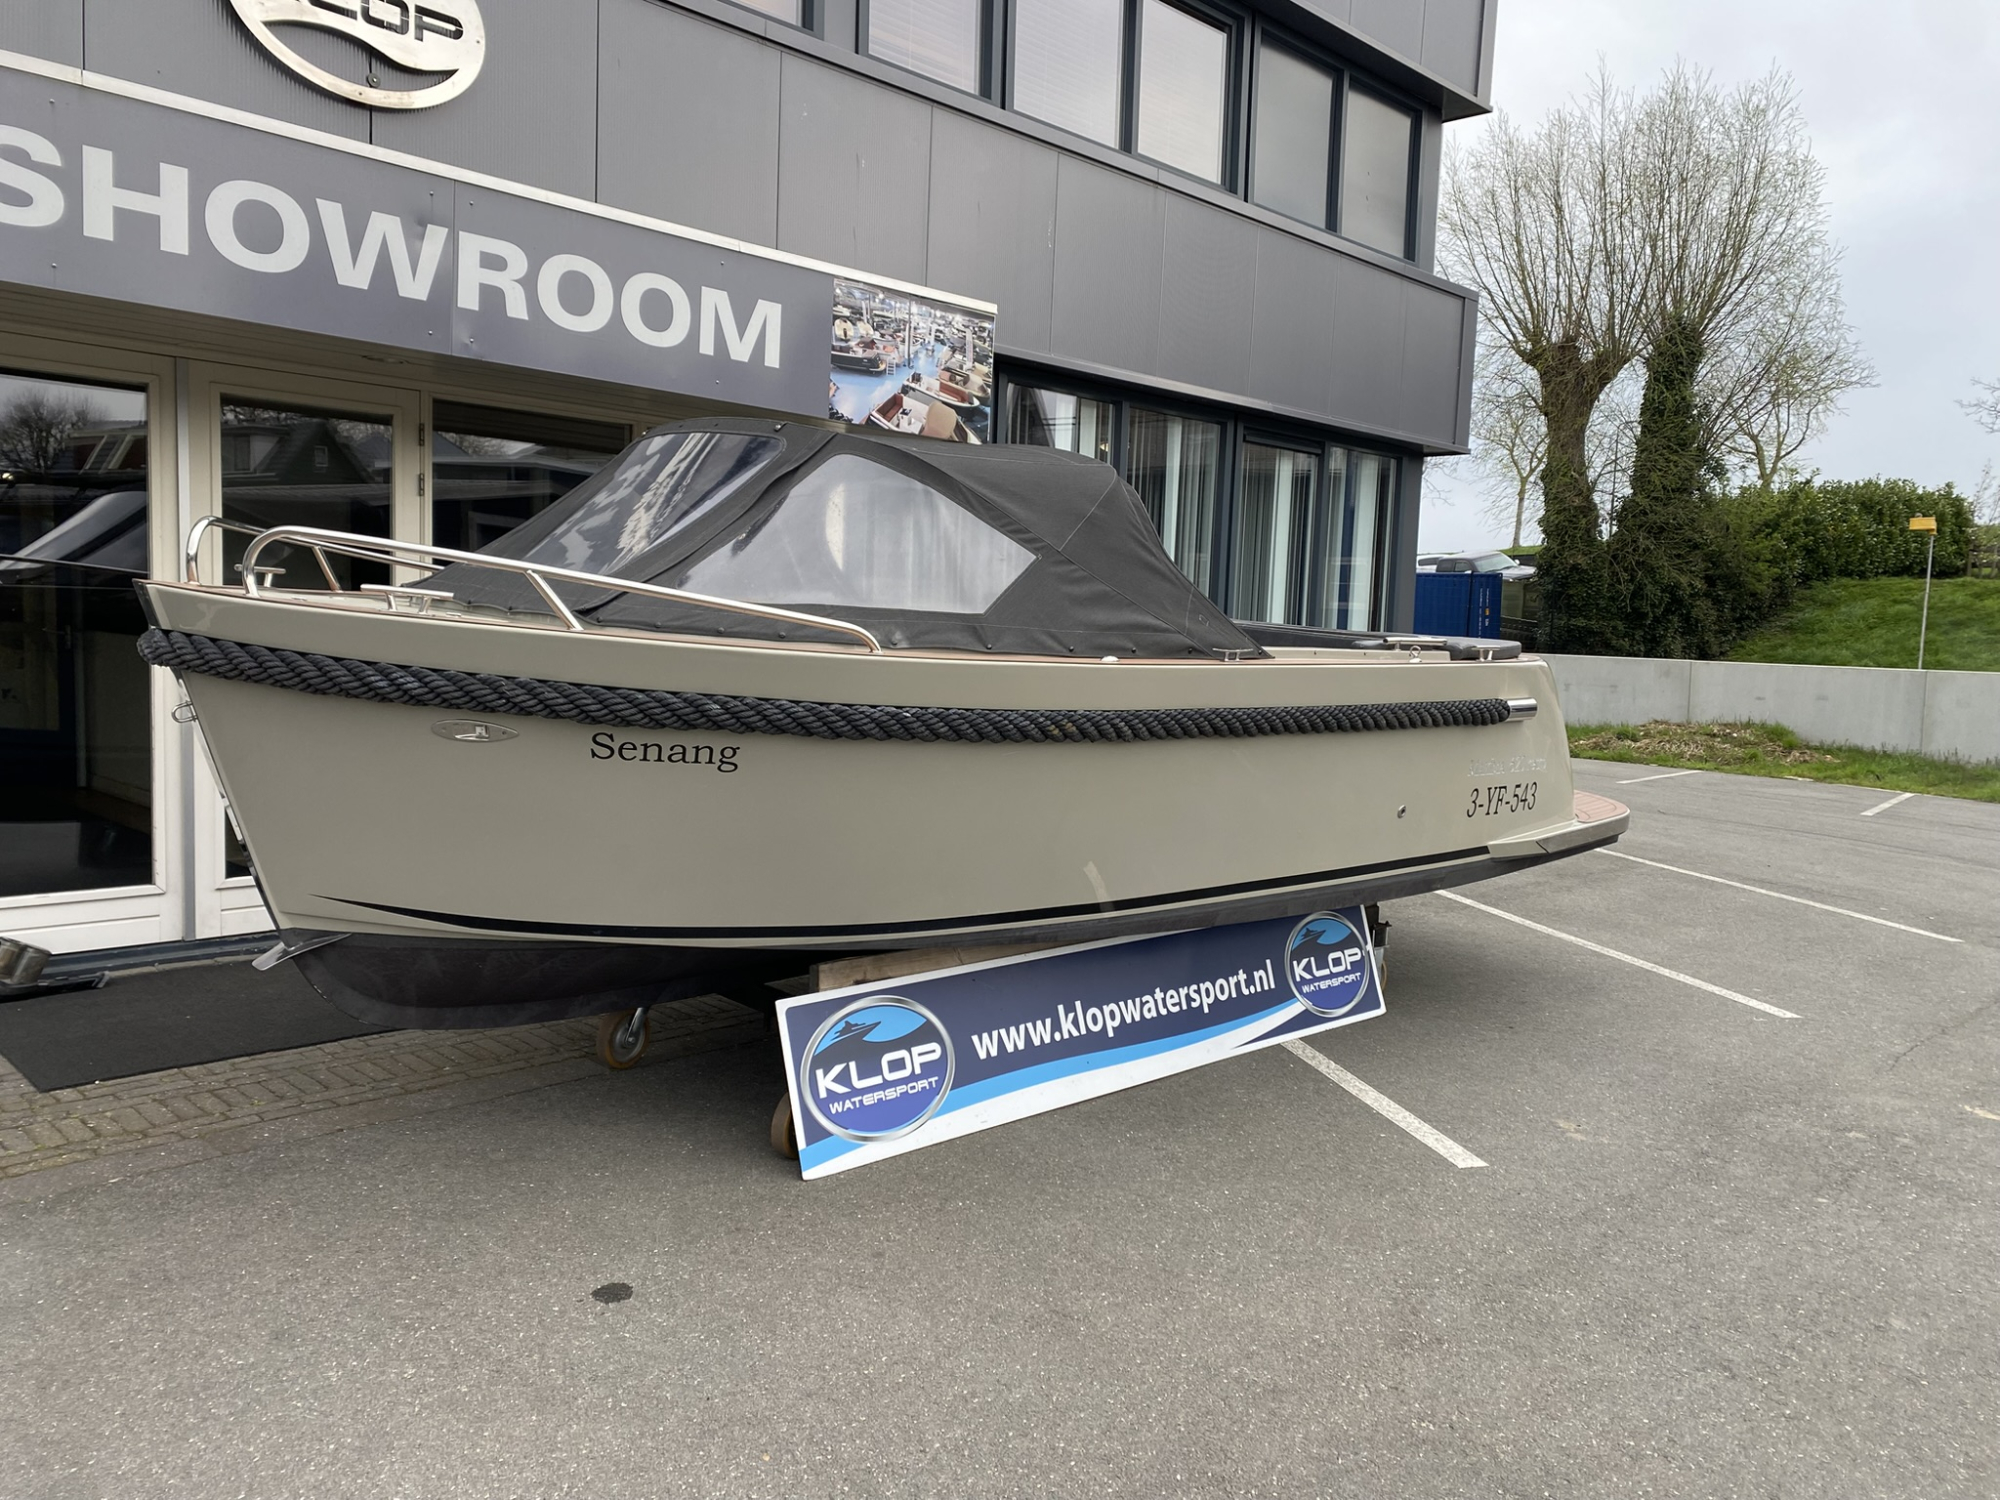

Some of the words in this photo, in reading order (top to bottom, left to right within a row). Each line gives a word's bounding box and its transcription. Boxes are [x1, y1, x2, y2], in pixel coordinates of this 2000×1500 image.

[0, 124, 782, 369] SHOWROOM
[590, 732, 741, 773] Senang
[1466, 781, 1538, 818] 3-YF-543
[1292, 947, 1362, 982] KLOP
[1301, 972, 1361, 993] WATERSPORT
[971, 959, 1276, 1061] www.klopwatersport.nl
[815, 1042, 942, 1099] KLOP
[829, 1076, 939, 1115] WATERSPORT
